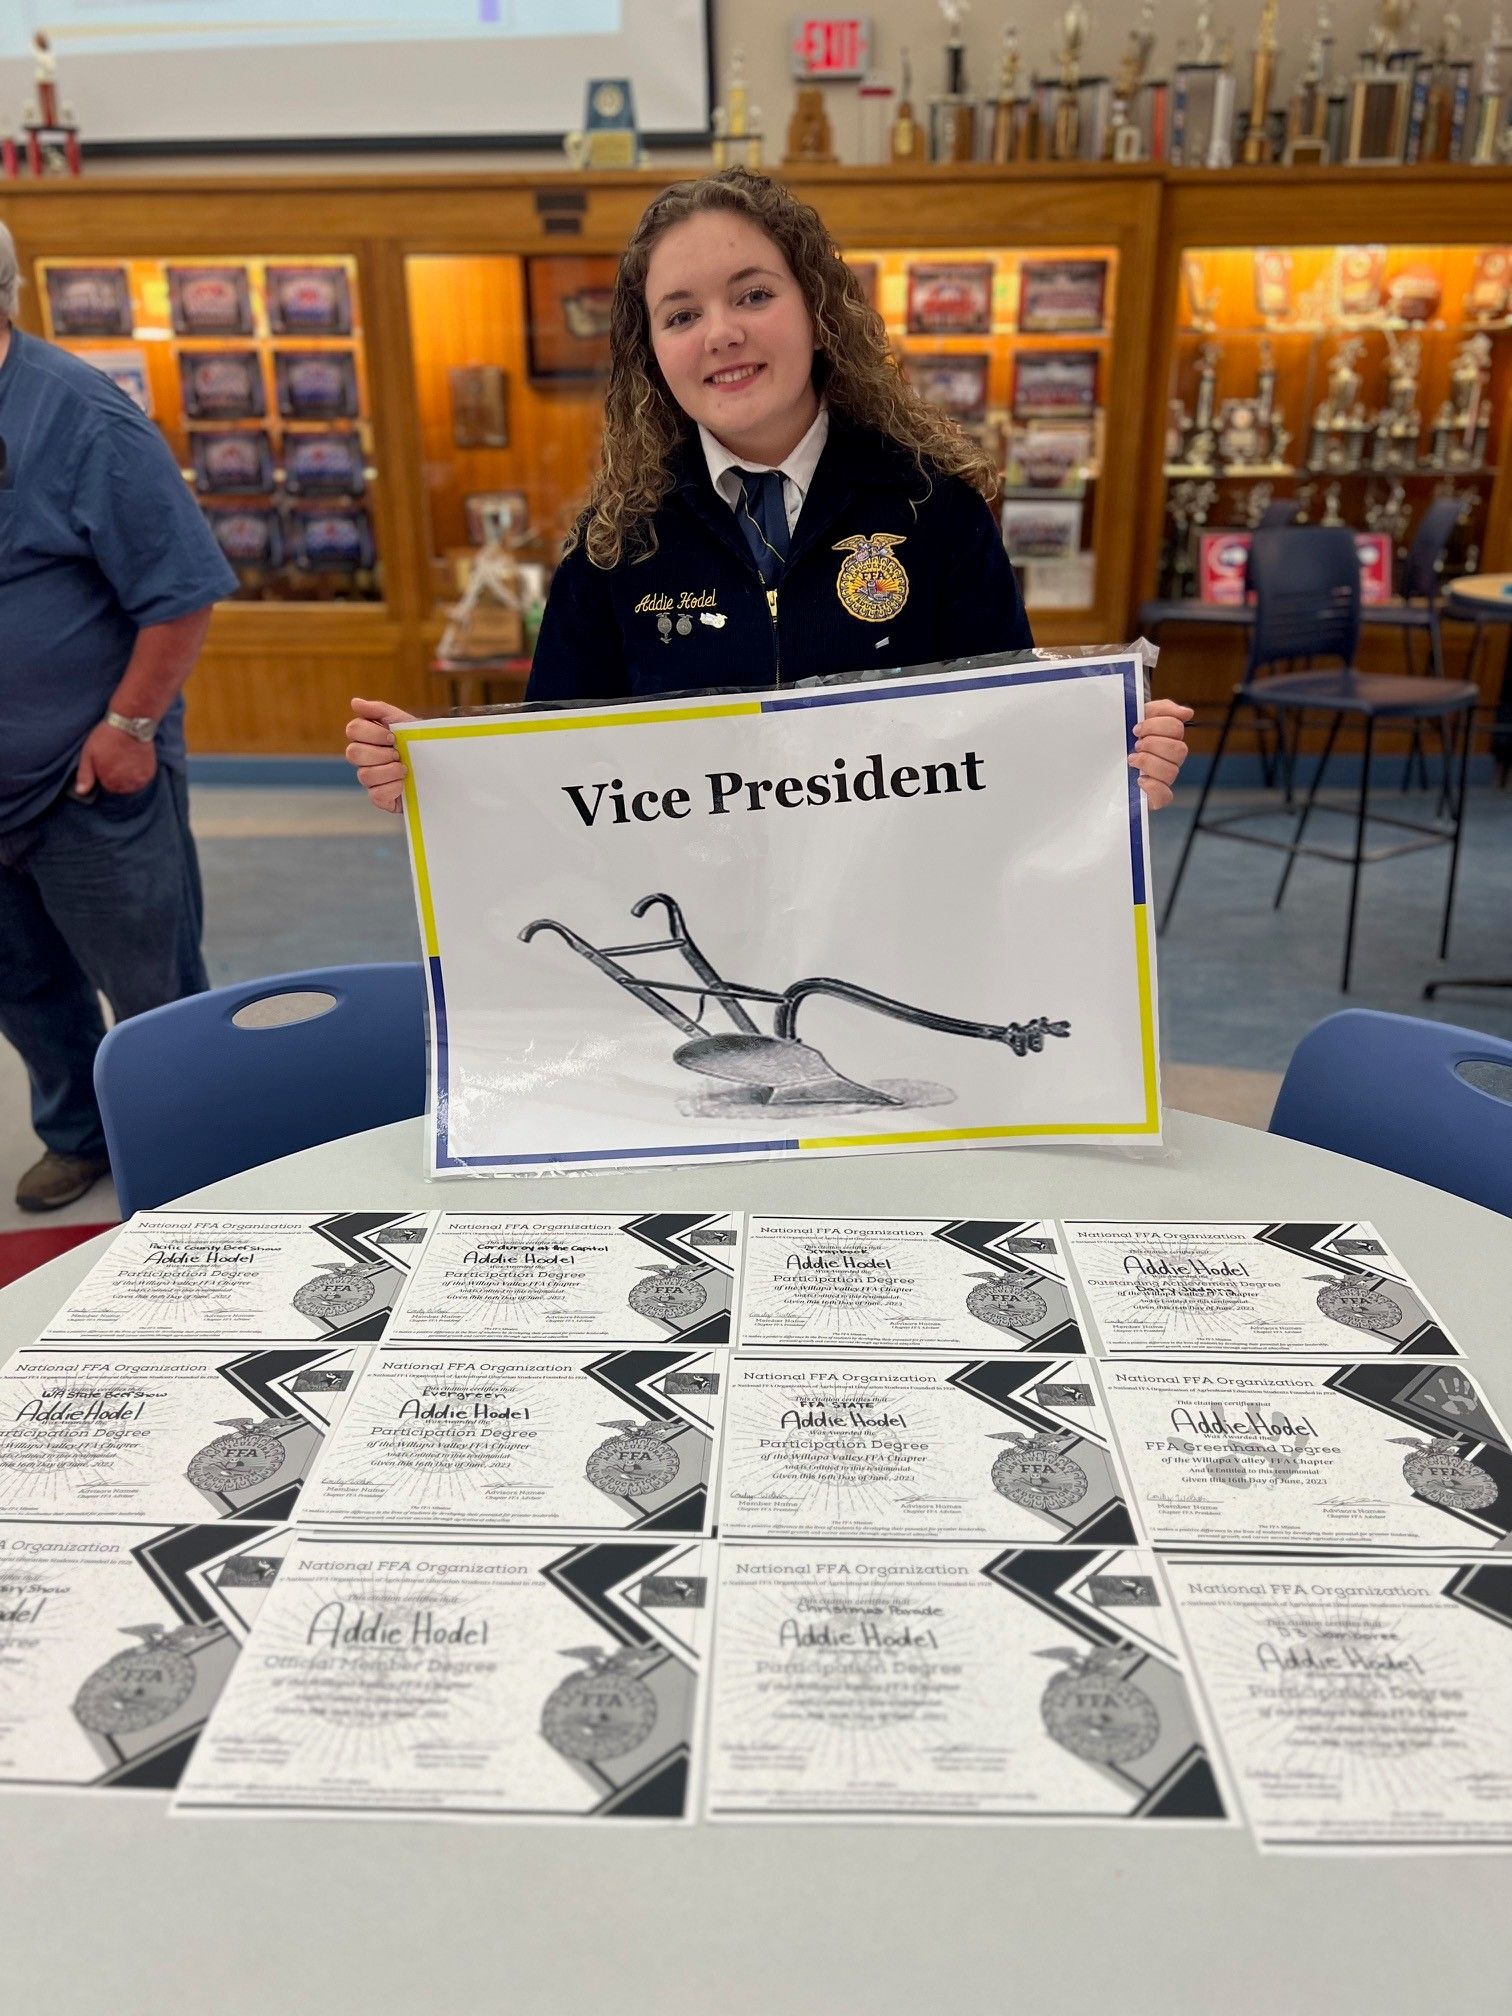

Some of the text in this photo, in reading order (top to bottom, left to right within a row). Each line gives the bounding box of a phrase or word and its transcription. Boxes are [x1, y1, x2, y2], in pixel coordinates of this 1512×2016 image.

[803, 19, 858, 68] EXIT
[635, 589, 717, 613] Addie Hodel
[562, 752, 987, 826] Vice President
[761, 1227, 813, 1235] National
[843, 1228, 924, 1237] Organization
[1078, 1231, 1246, 1241] National FFA Organization
[144, 1251, 254, 1263] Addie Hodel
[463, 1252, 575, 1264] Addie Hodel
[787, 1255, 891, 1270] Addie Hodel
[1123, 1256, 1249, 1277] Addie Hodel
[118, 1270, 207, 1278] Participation
[445, 1271, 585, 1280] Participation Degree
[774, 1275, 915, 1284] Participation Degree
[1088, 1279, 1162, 1288] Outstanding
[1240, 1281, 1281, 1289] Degree
[16, 1364, 206, 1373] National FFA Organization
[382, 1362, 572, 1372] National FFA Organization
[743, 1372, 936, 1383] National FFA Organization
[1116, 1374, 1314, 1388] National FFA Organization
[422, 1388, 507, 1400] Evergreen
[16, 1400, 145, 1422] Addie Hodel
[399, 1399, 530, 1419] Addie Hodel
[781, 1411, 907, 1429] Addie Hodel
[1171, 1408, 1319, 1437] Addie Hodel
[0, 1429, 151, 1439] articipation Degree
[371, 1427, 537, 1439] Participation Degree
[398, 1441, 435, 1449] Willapa
[438, 1442, 468, 1450] Valley
[760, 1438, 929, 1451] Participation Degree
[1146, 1441, 1341, 1456] FFA Greenhand Degree
[226, 1449, 258, 1457] FFA
[619, 1452, 652, 1461] FFA
[792, 1454, 829, 1462] Willapa
[887, 1455, 927, 1463] Chapter
[1192, 1457, 1231, 1465] Willapa
[1234, 1457, 1266, 1465] Valley
[1293, 1458, 1335, 1466] Chapter
[1021, 1464, 1056, 1473] FFA
[1429, 1467, 1464, 1476] FFA
[12, 1541, 119, 1553] Organization
[298, 1560, 529, 1575] National FFA Organization
[736, 1564, 968, 1577] National FFA Organization
[1188, 1583, 1431, 1598] National FFA Organization
[797, 1603, 944, 1617] Christmas Parade
[307, 1602, 489, 1648] Addie Hodel
[779, 1619, 938, 1649] Addie Hodel
[1257, 1642, 1424, 1675] Addie Hodel
[264, 1656, 496, 1676] Official Member Degree
[756, 1662, 962, 1677] Participation Degree
[123, 1669, 162, 1682] FFA
[582, 1693, 622, 1706] FFA
